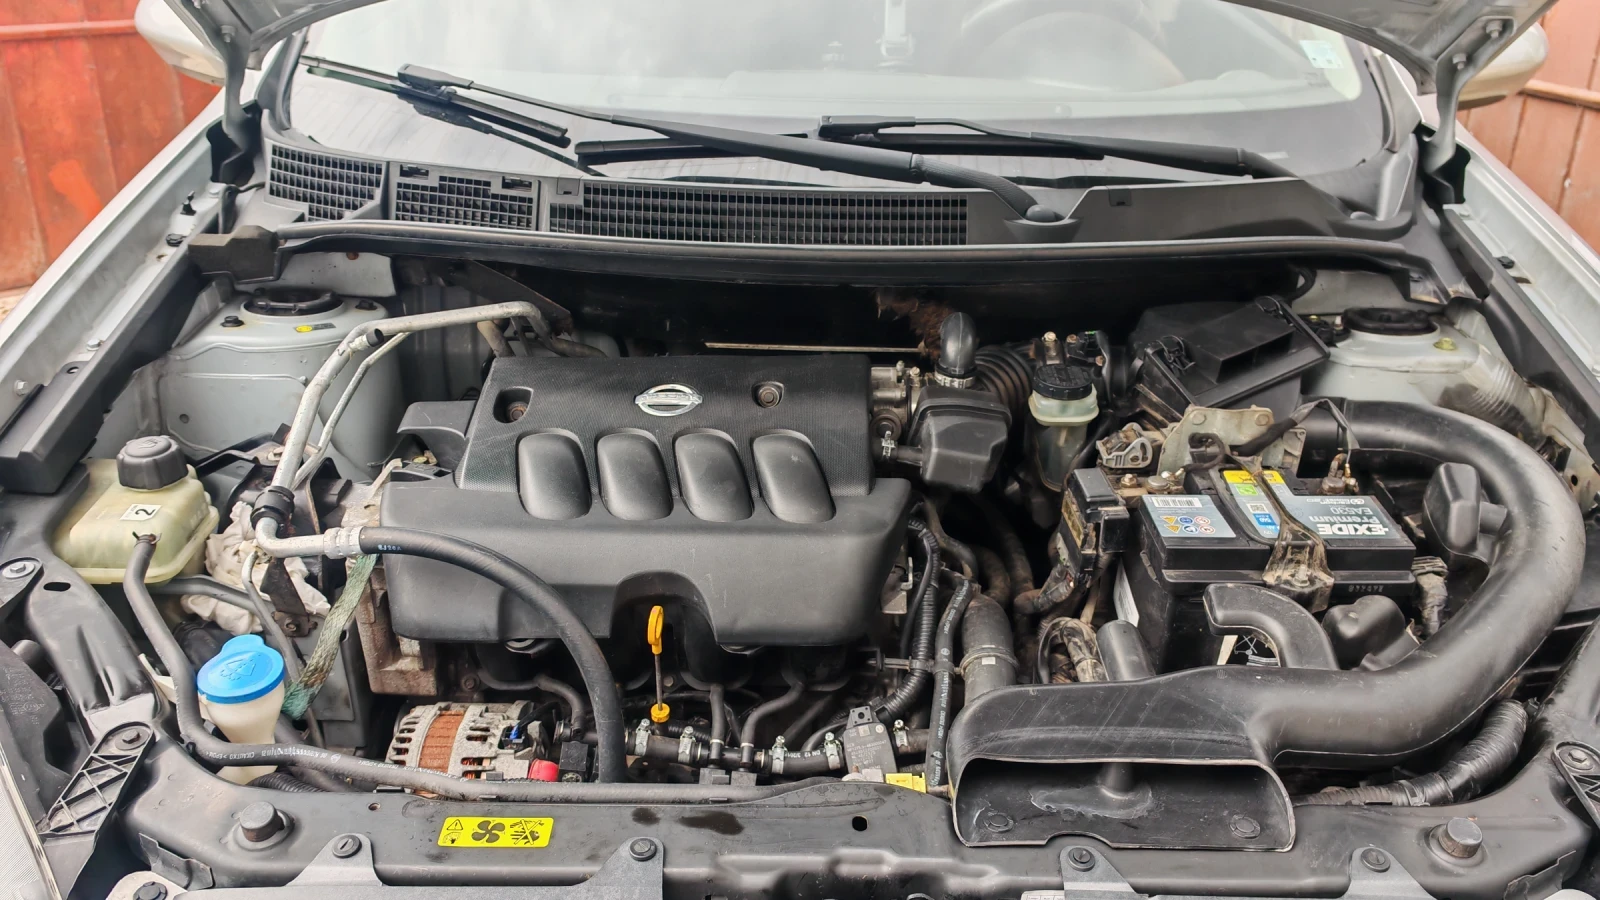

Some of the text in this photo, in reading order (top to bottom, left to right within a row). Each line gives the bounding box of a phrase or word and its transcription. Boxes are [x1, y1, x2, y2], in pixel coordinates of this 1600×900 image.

[135, 508, 156, 516] 2
[1330, 507, 1374, 515] EA530
[1309, 515, 1380, 523] Premium
[1316, 523, 1389, 535] EXIDE
